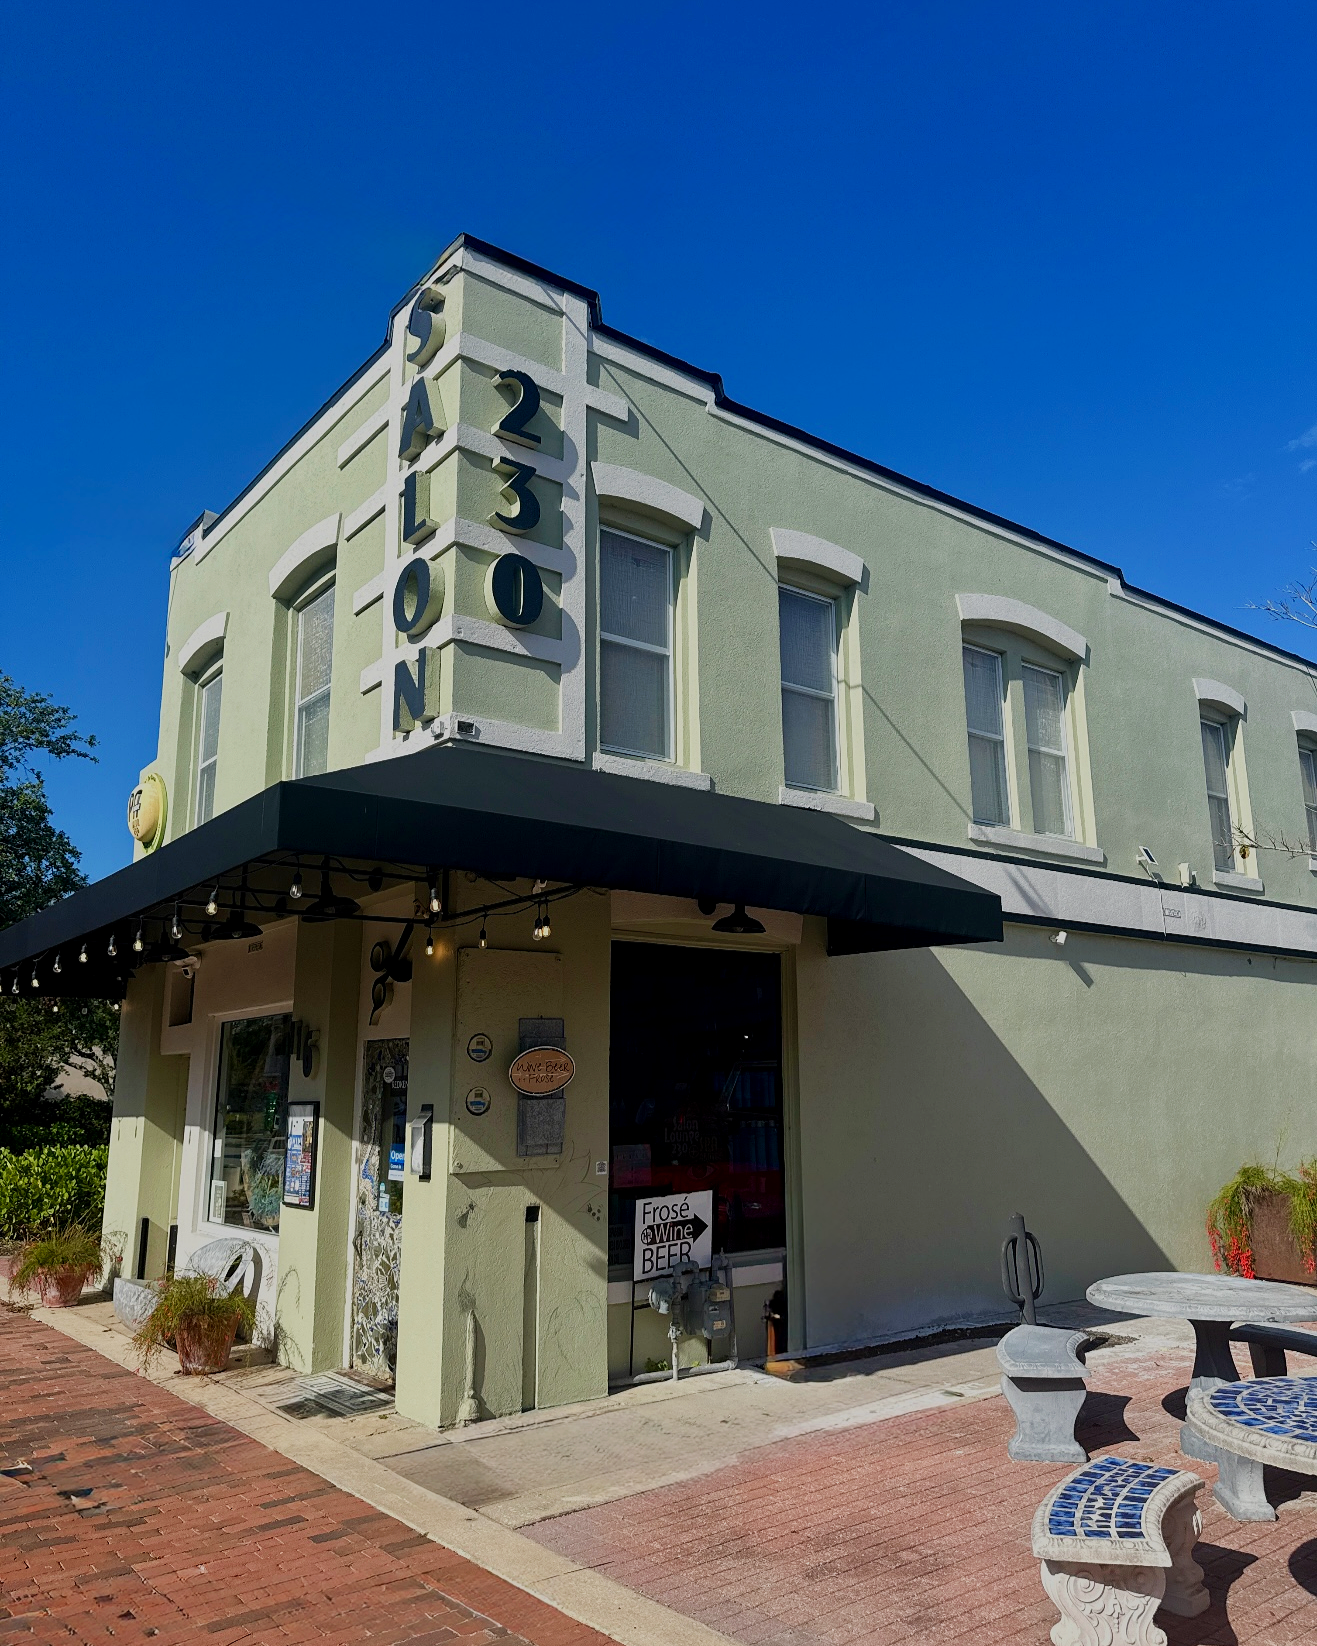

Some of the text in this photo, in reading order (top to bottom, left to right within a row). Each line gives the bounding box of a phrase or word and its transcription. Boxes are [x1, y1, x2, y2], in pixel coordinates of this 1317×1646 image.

[393, 288, 446, 733] SALON
[485, 370, 543, 629] 230
[664, 1127, 700, 1145] Lounge
[671, 1142, 688, 1157] 230
[642, 1195, 690, 1225] Frosé
[653, 1222, 694, 1244] Wine
[641, 1240, 692, 1275] BEER
